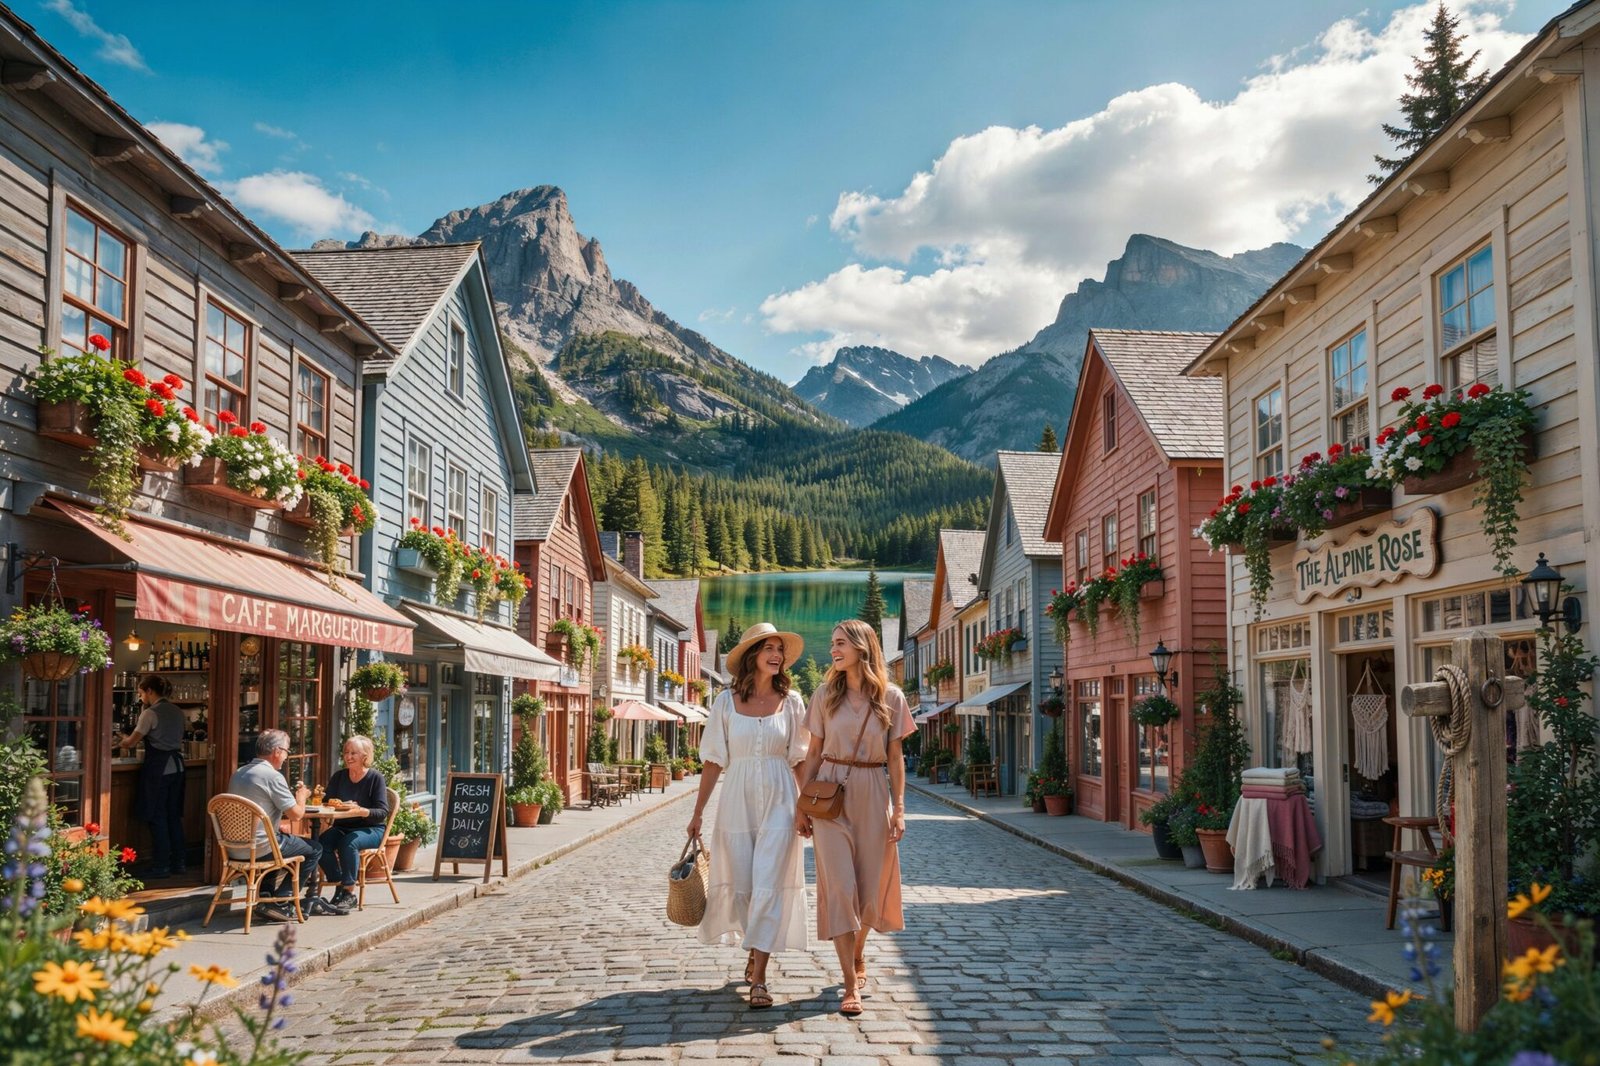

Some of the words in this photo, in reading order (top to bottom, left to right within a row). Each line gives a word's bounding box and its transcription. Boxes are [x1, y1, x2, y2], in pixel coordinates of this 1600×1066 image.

[1296, 557, 1322, 590] THE
[1324, 544, 1375, 586] ALPINE
[1378, 529, 1424, 572] ROSE
[222, 593, 276, 631] CAFE
[286, 606, 380, 645] MARGUERITE
[454, 783, 490, 797] FRESH
[453, 801, 489, 815] BREAD
[451, 817, 484, 832] DAILY
